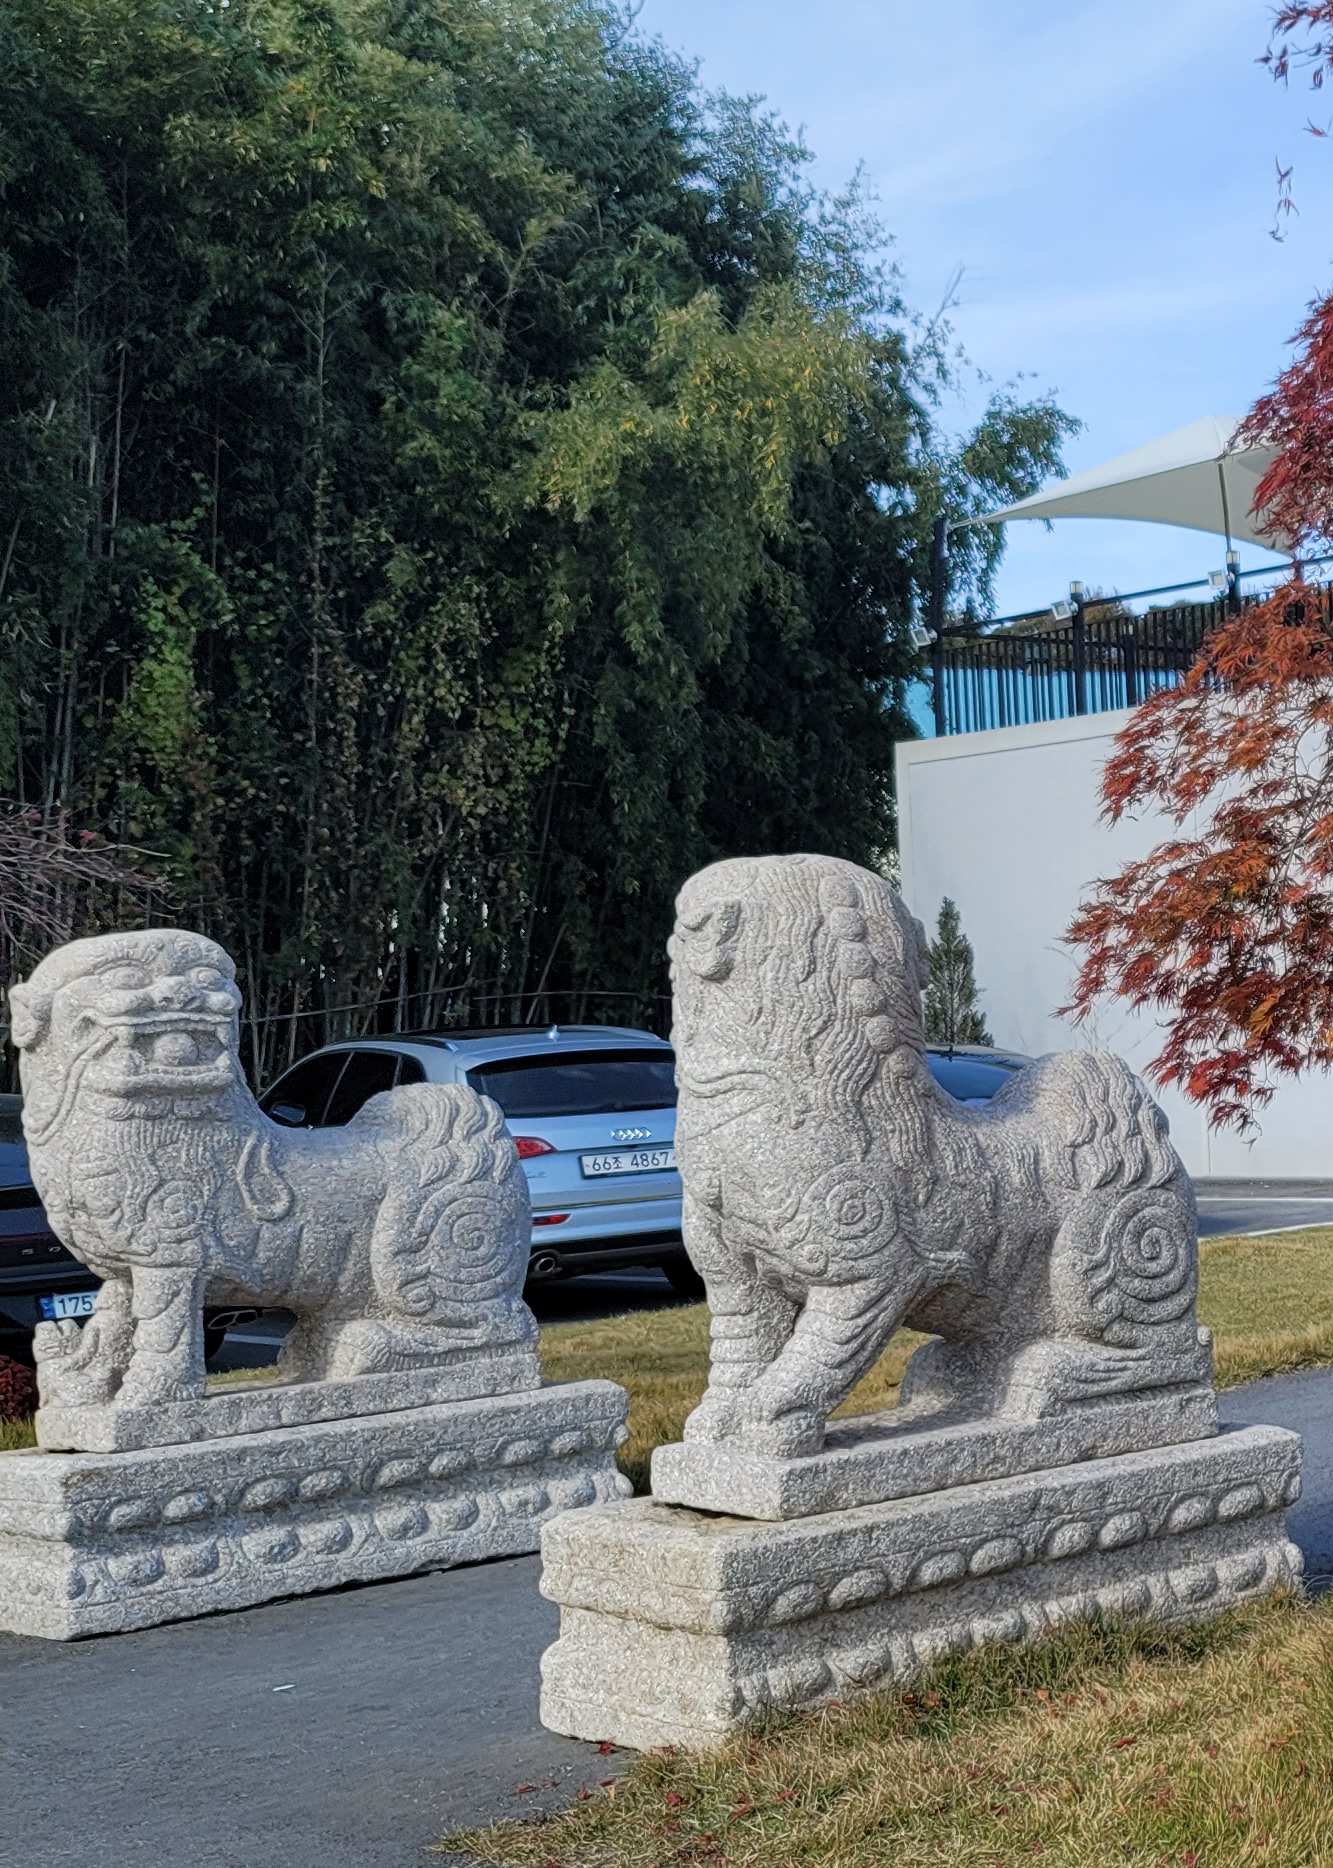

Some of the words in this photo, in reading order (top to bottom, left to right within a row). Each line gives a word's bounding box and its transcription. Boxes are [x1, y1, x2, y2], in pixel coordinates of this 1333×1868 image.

[592, 1156, 623, 1172] 66조
[630, 1151, 669, 1168] 4867
[58, 1294, 97, 1315] 175
